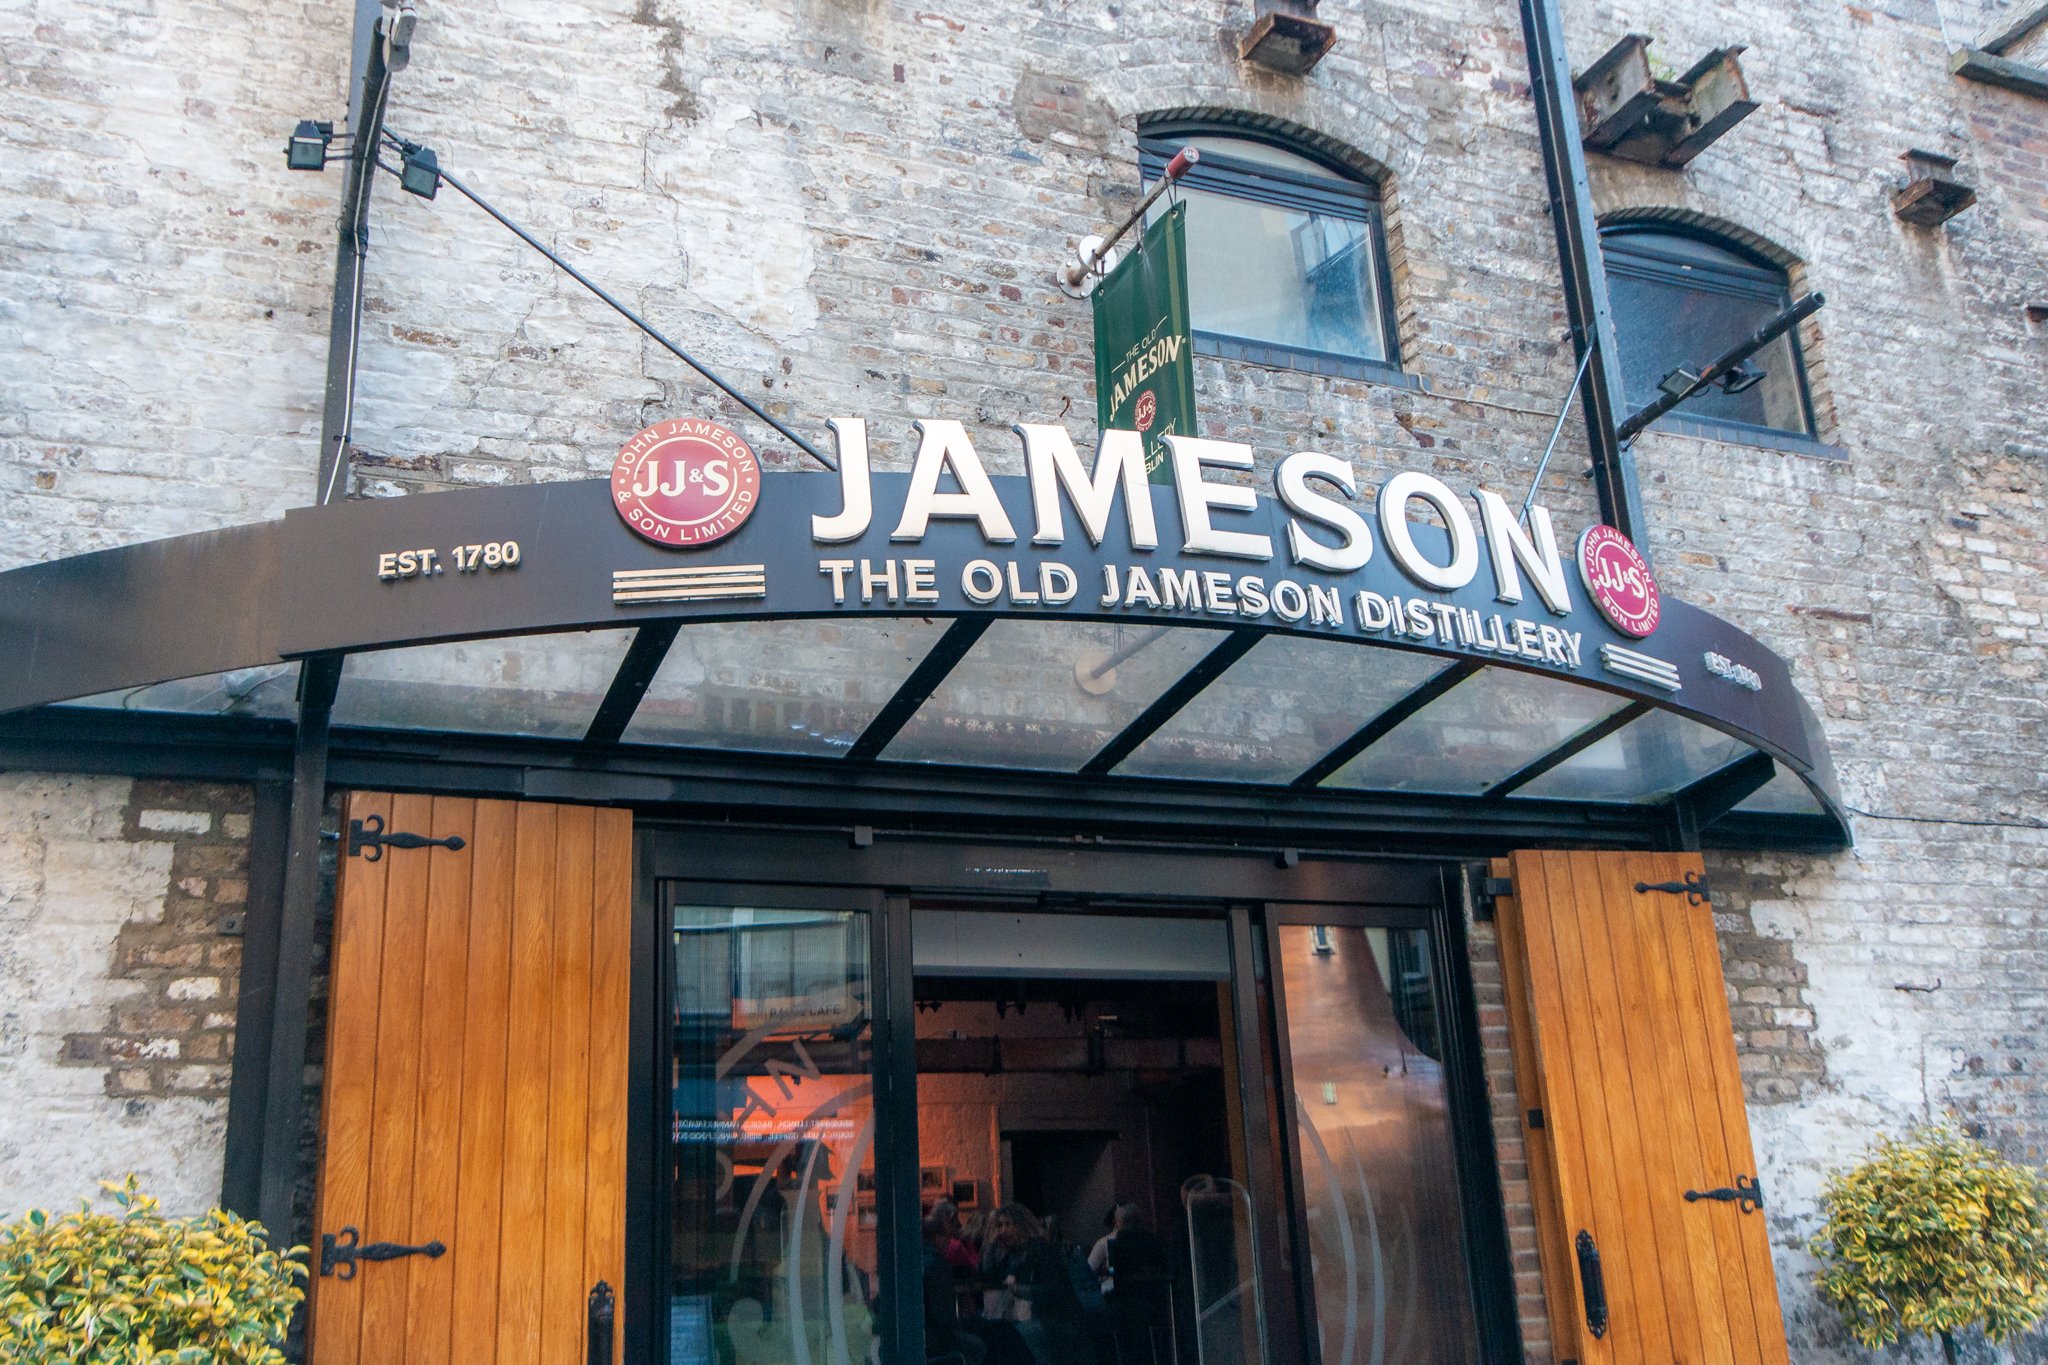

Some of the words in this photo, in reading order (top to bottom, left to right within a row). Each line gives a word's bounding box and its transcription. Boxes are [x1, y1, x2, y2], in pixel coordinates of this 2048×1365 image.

[1126, 343, 1140, 362] THE
[1141, 328, 1157, 349] OLD
[1109, 335, 1182, 422] JAMESON
[618, 430, 660, 475] JOHN
[669, 422, 754, 473] JAMESON
[1145, 451, 1164, 475] BLIN
[632, 460, 730, 497] JJ&S
[628, 508, 671, 539] SON
[680, 490, 753, 541] LIMITED
[811, 417, 1573, 617] JAMESON
[378, 547, 444, 582] EST.
[451, 540, 521, 574] 1780
[1586, 530, 1601, 567] JOHN
[1603, 528, 1652, 583] JAMESON
[1598, 557, 1646, 599] JJ&S
[819, 559, 940, 604] THE
[961, 559, 1079, 606] OLD
[1101, 564, 1342, 628] JAMESON
[1355, 589, 1583, 670] DISTILLERY
[1602, 596, 1628, 627] SON
[1631, 597, 1658, 633] LIMITED
